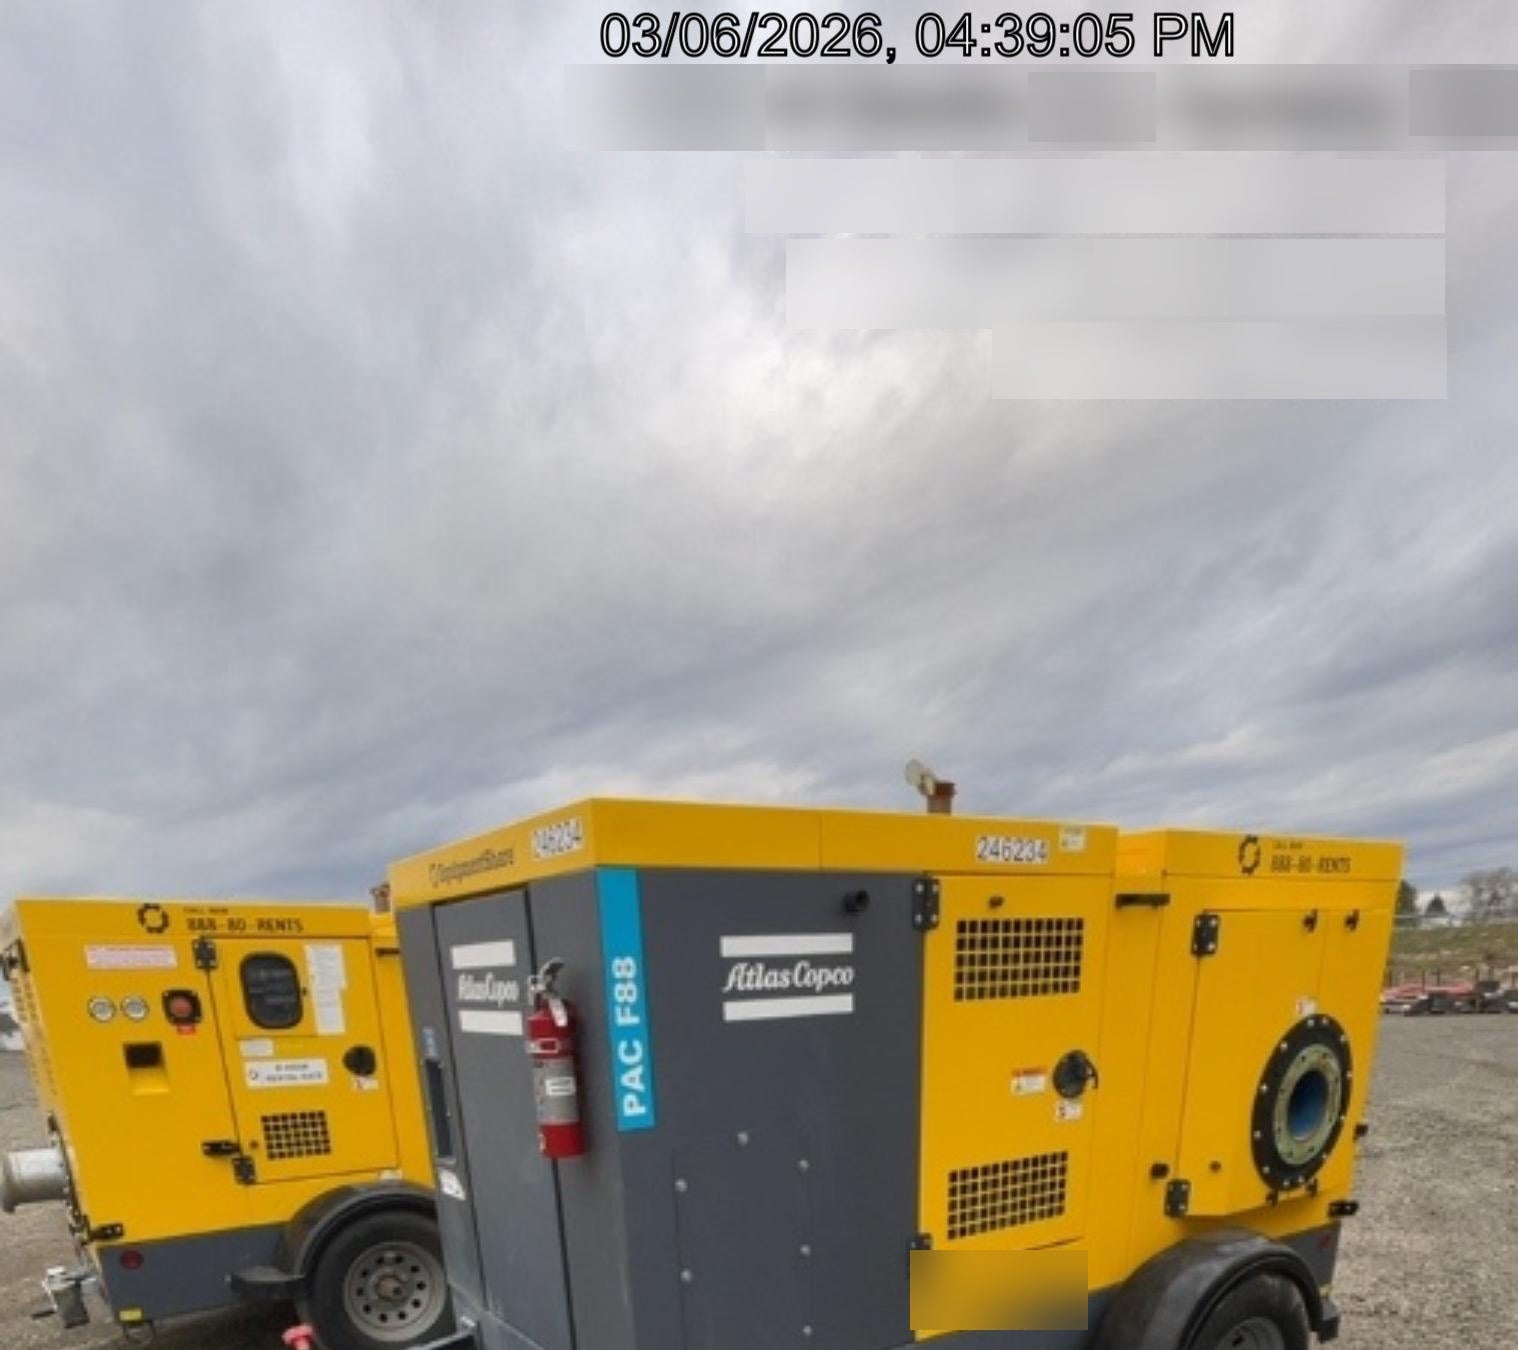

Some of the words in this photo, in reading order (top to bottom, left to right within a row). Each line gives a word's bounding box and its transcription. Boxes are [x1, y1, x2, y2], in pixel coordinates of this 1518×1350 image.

[976, 835, 1047, 863] 246234
[611, 955, 641, 1027] F88
[617, 1039, 647, 1117] PAC
